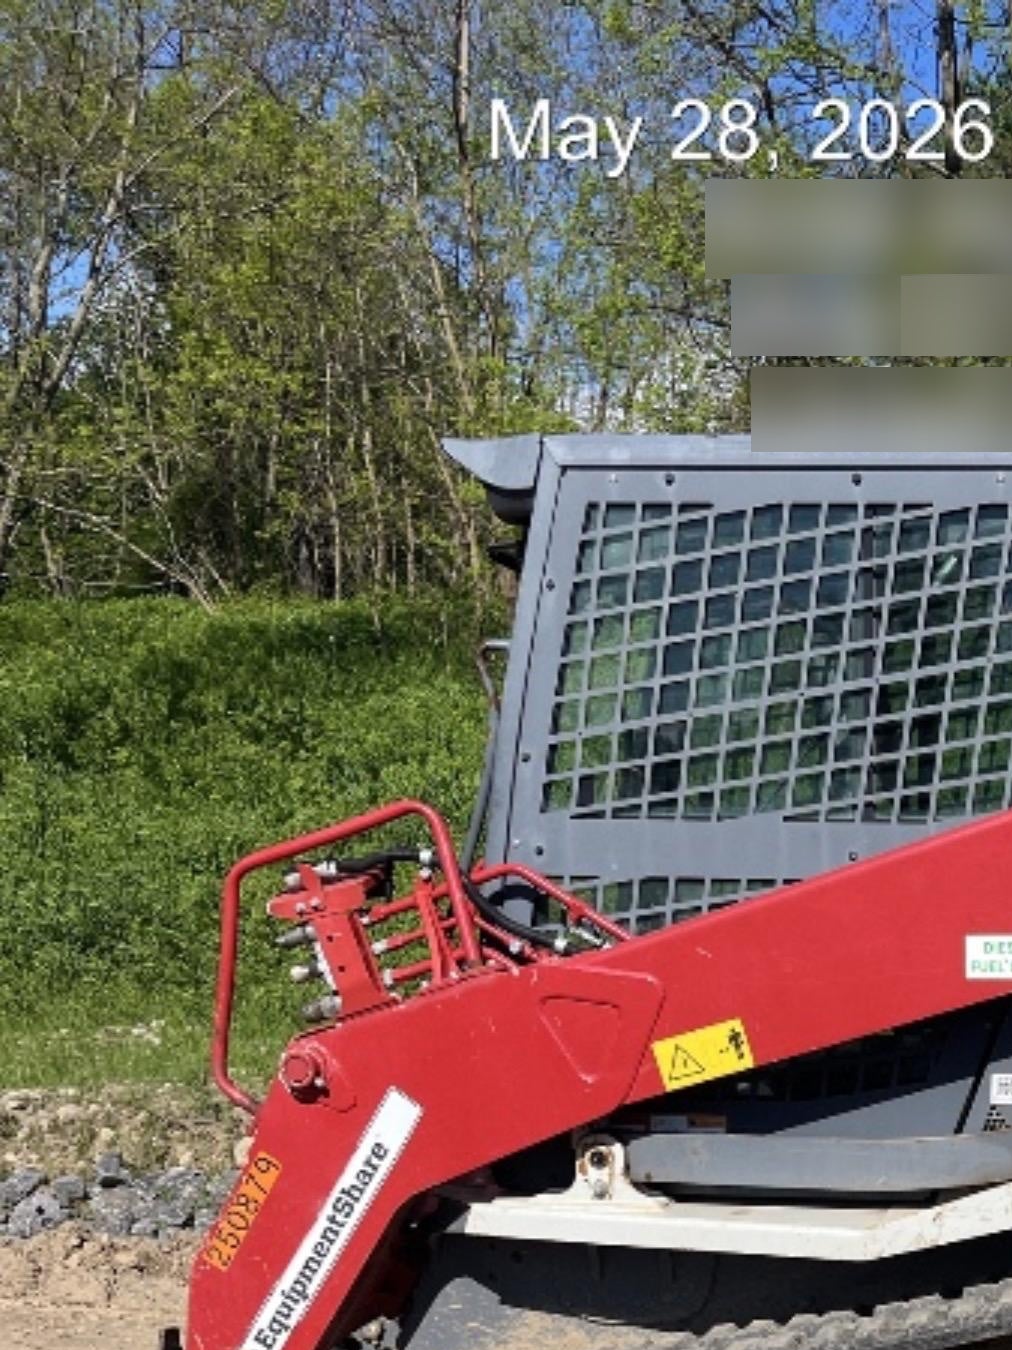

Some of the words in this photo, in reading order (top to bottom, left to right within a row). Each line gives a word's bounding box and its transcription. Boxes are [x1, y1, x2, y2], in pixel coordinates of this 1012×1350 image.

[971, 959, 1005, 973] FUEL
[207, 1155, 280, 1268] 250879
[253, 1141, 390, 1350] EquipmentShare
